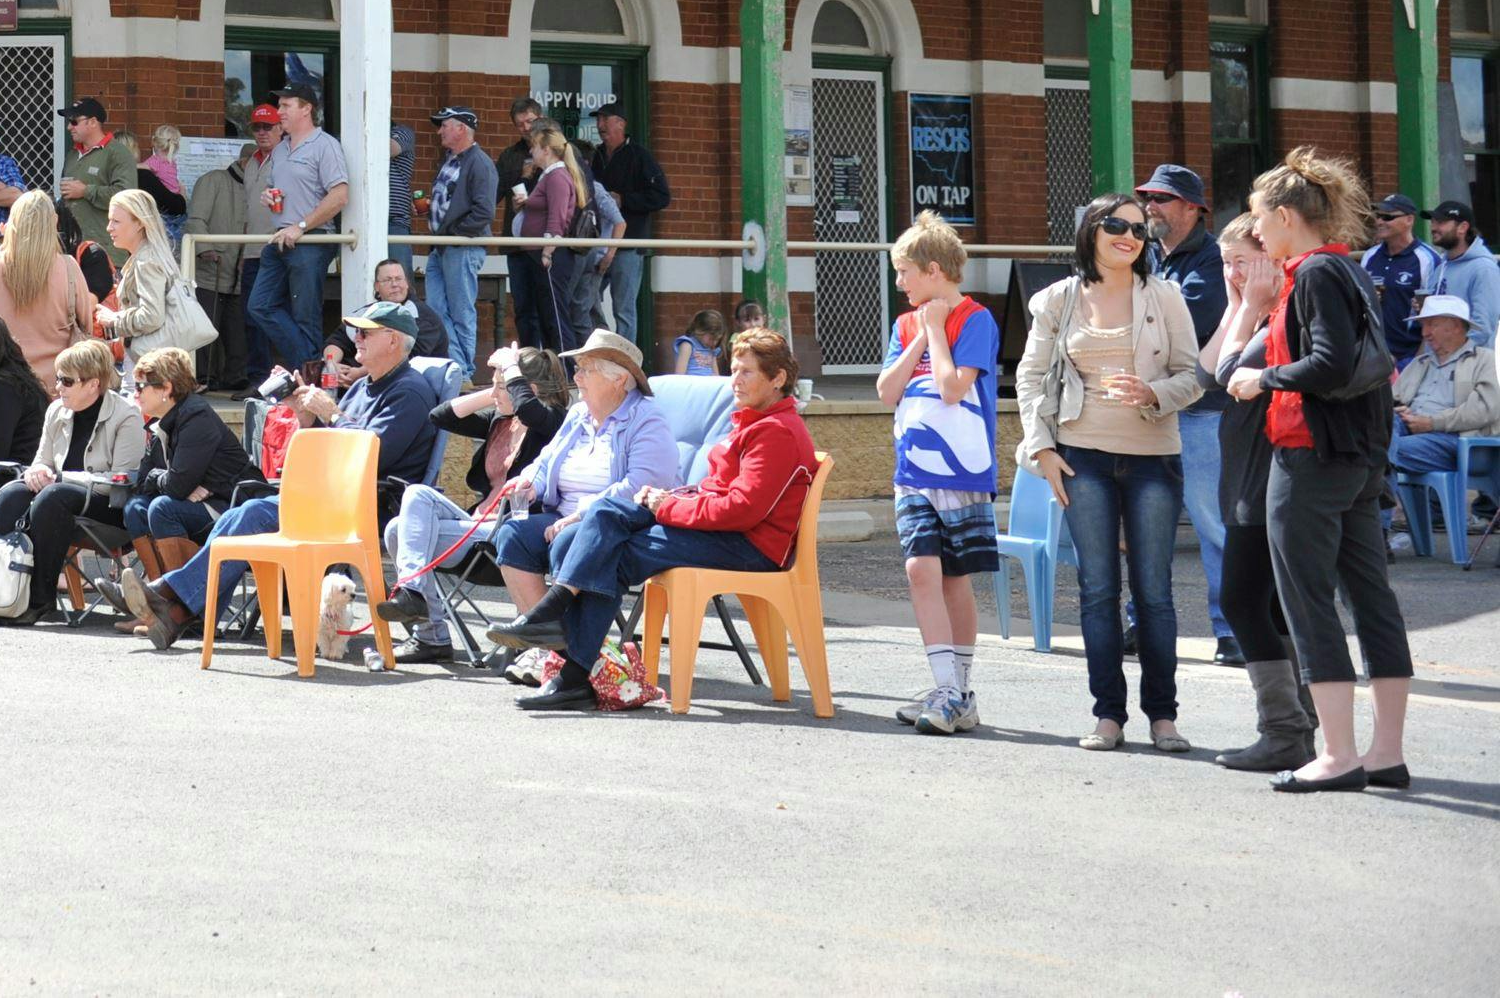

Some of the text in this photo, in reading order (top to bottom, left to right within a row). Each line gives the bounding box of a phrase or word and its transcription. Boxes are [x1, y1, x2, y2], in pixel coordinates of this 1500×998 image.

[912, 126, 970, 153] RESCHS
[916, 184, 970, 206] ON TAP
